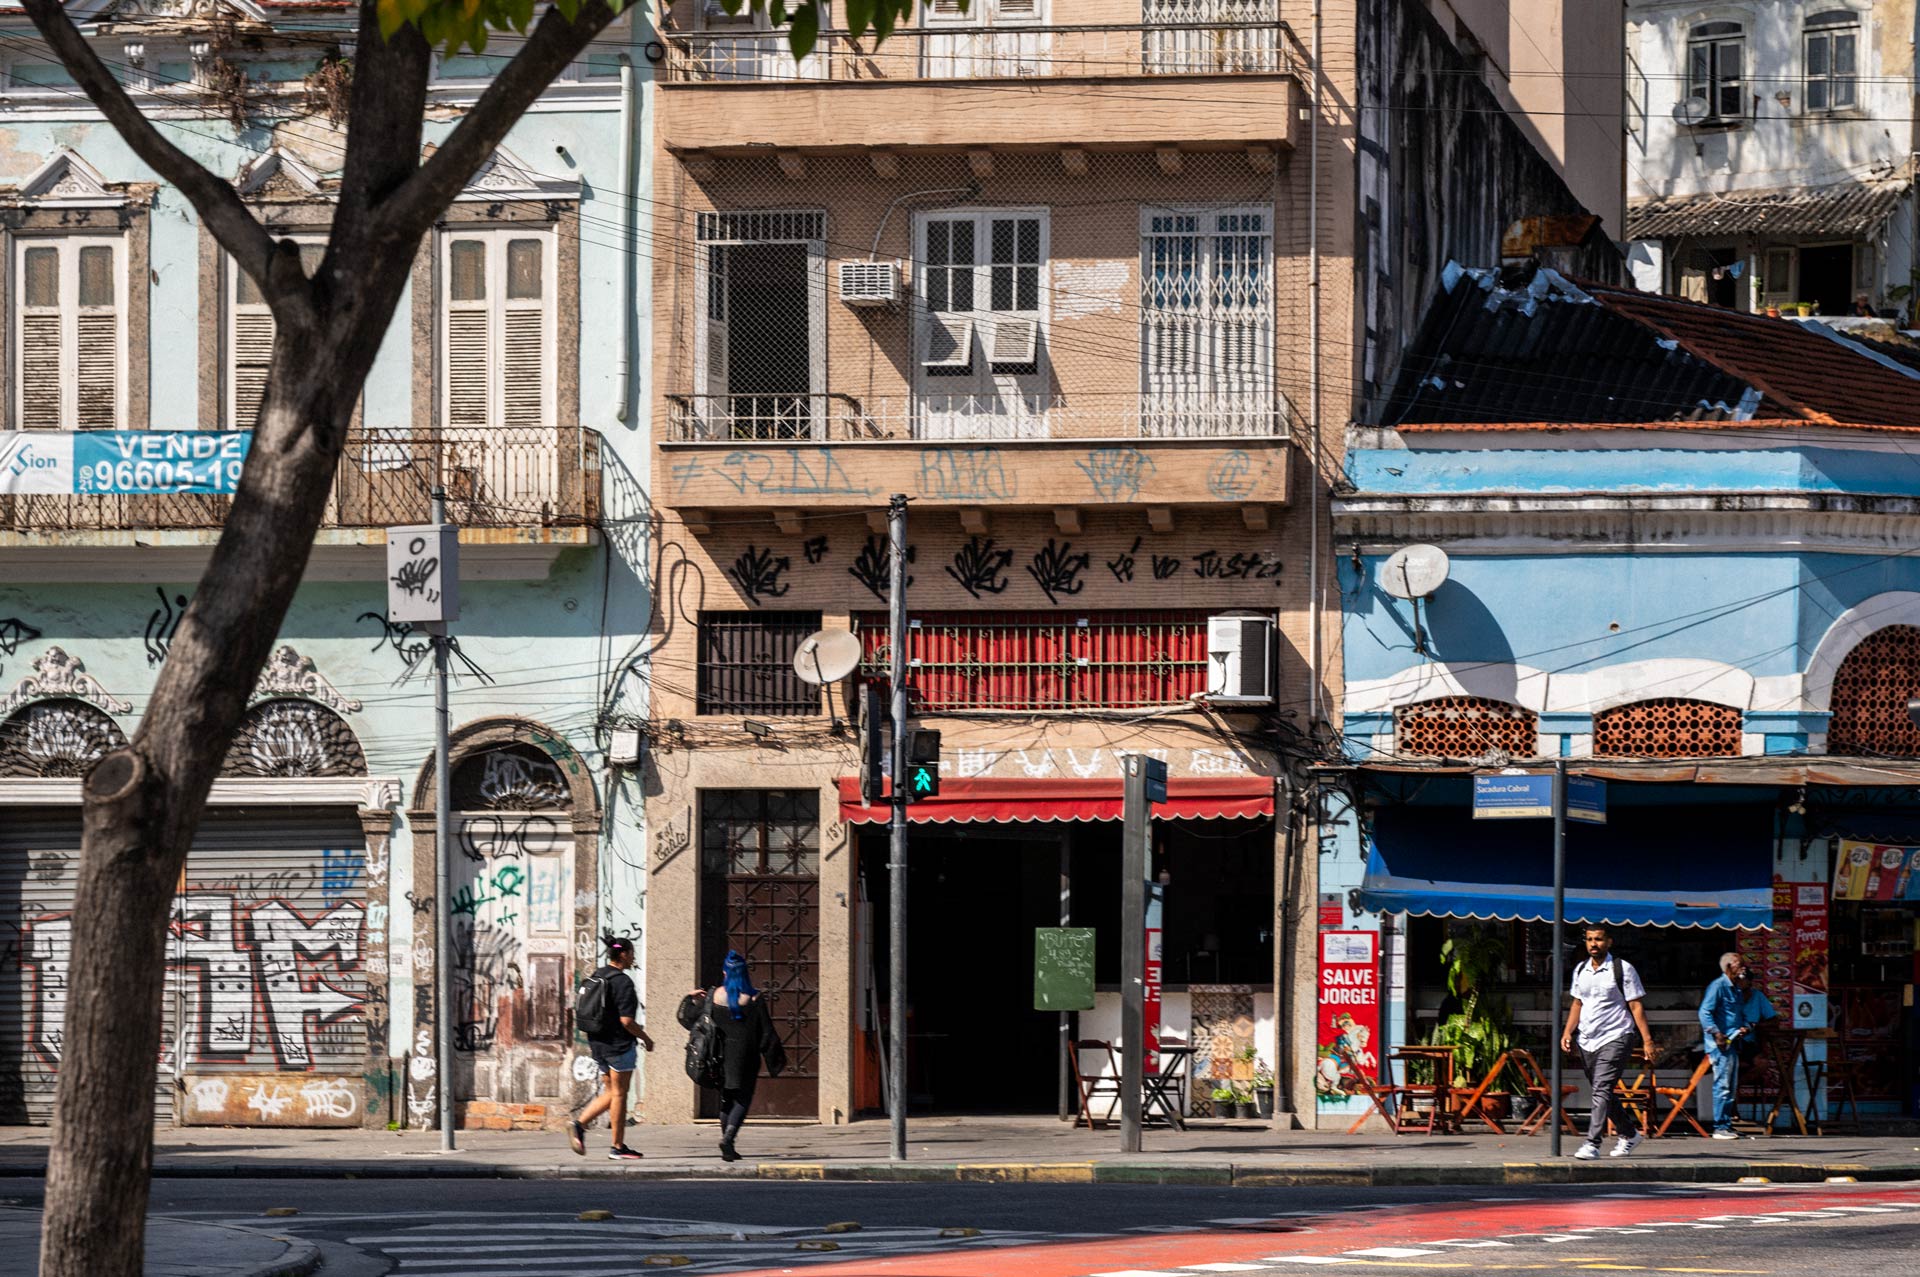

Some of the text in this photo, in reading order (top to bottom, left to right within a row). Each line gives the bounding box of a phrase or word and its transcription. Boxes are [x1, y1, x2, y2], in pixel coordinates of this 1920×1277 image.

[115, 434, 242, 459] VENDE
[1476, 777, 1490, 785] Rua
[1476, 784, 1530, 794] Sacadura Cabral
[1322, 968, 1374, 986] SALVE
[1318, 987, 1376, 1005] JORGE!
